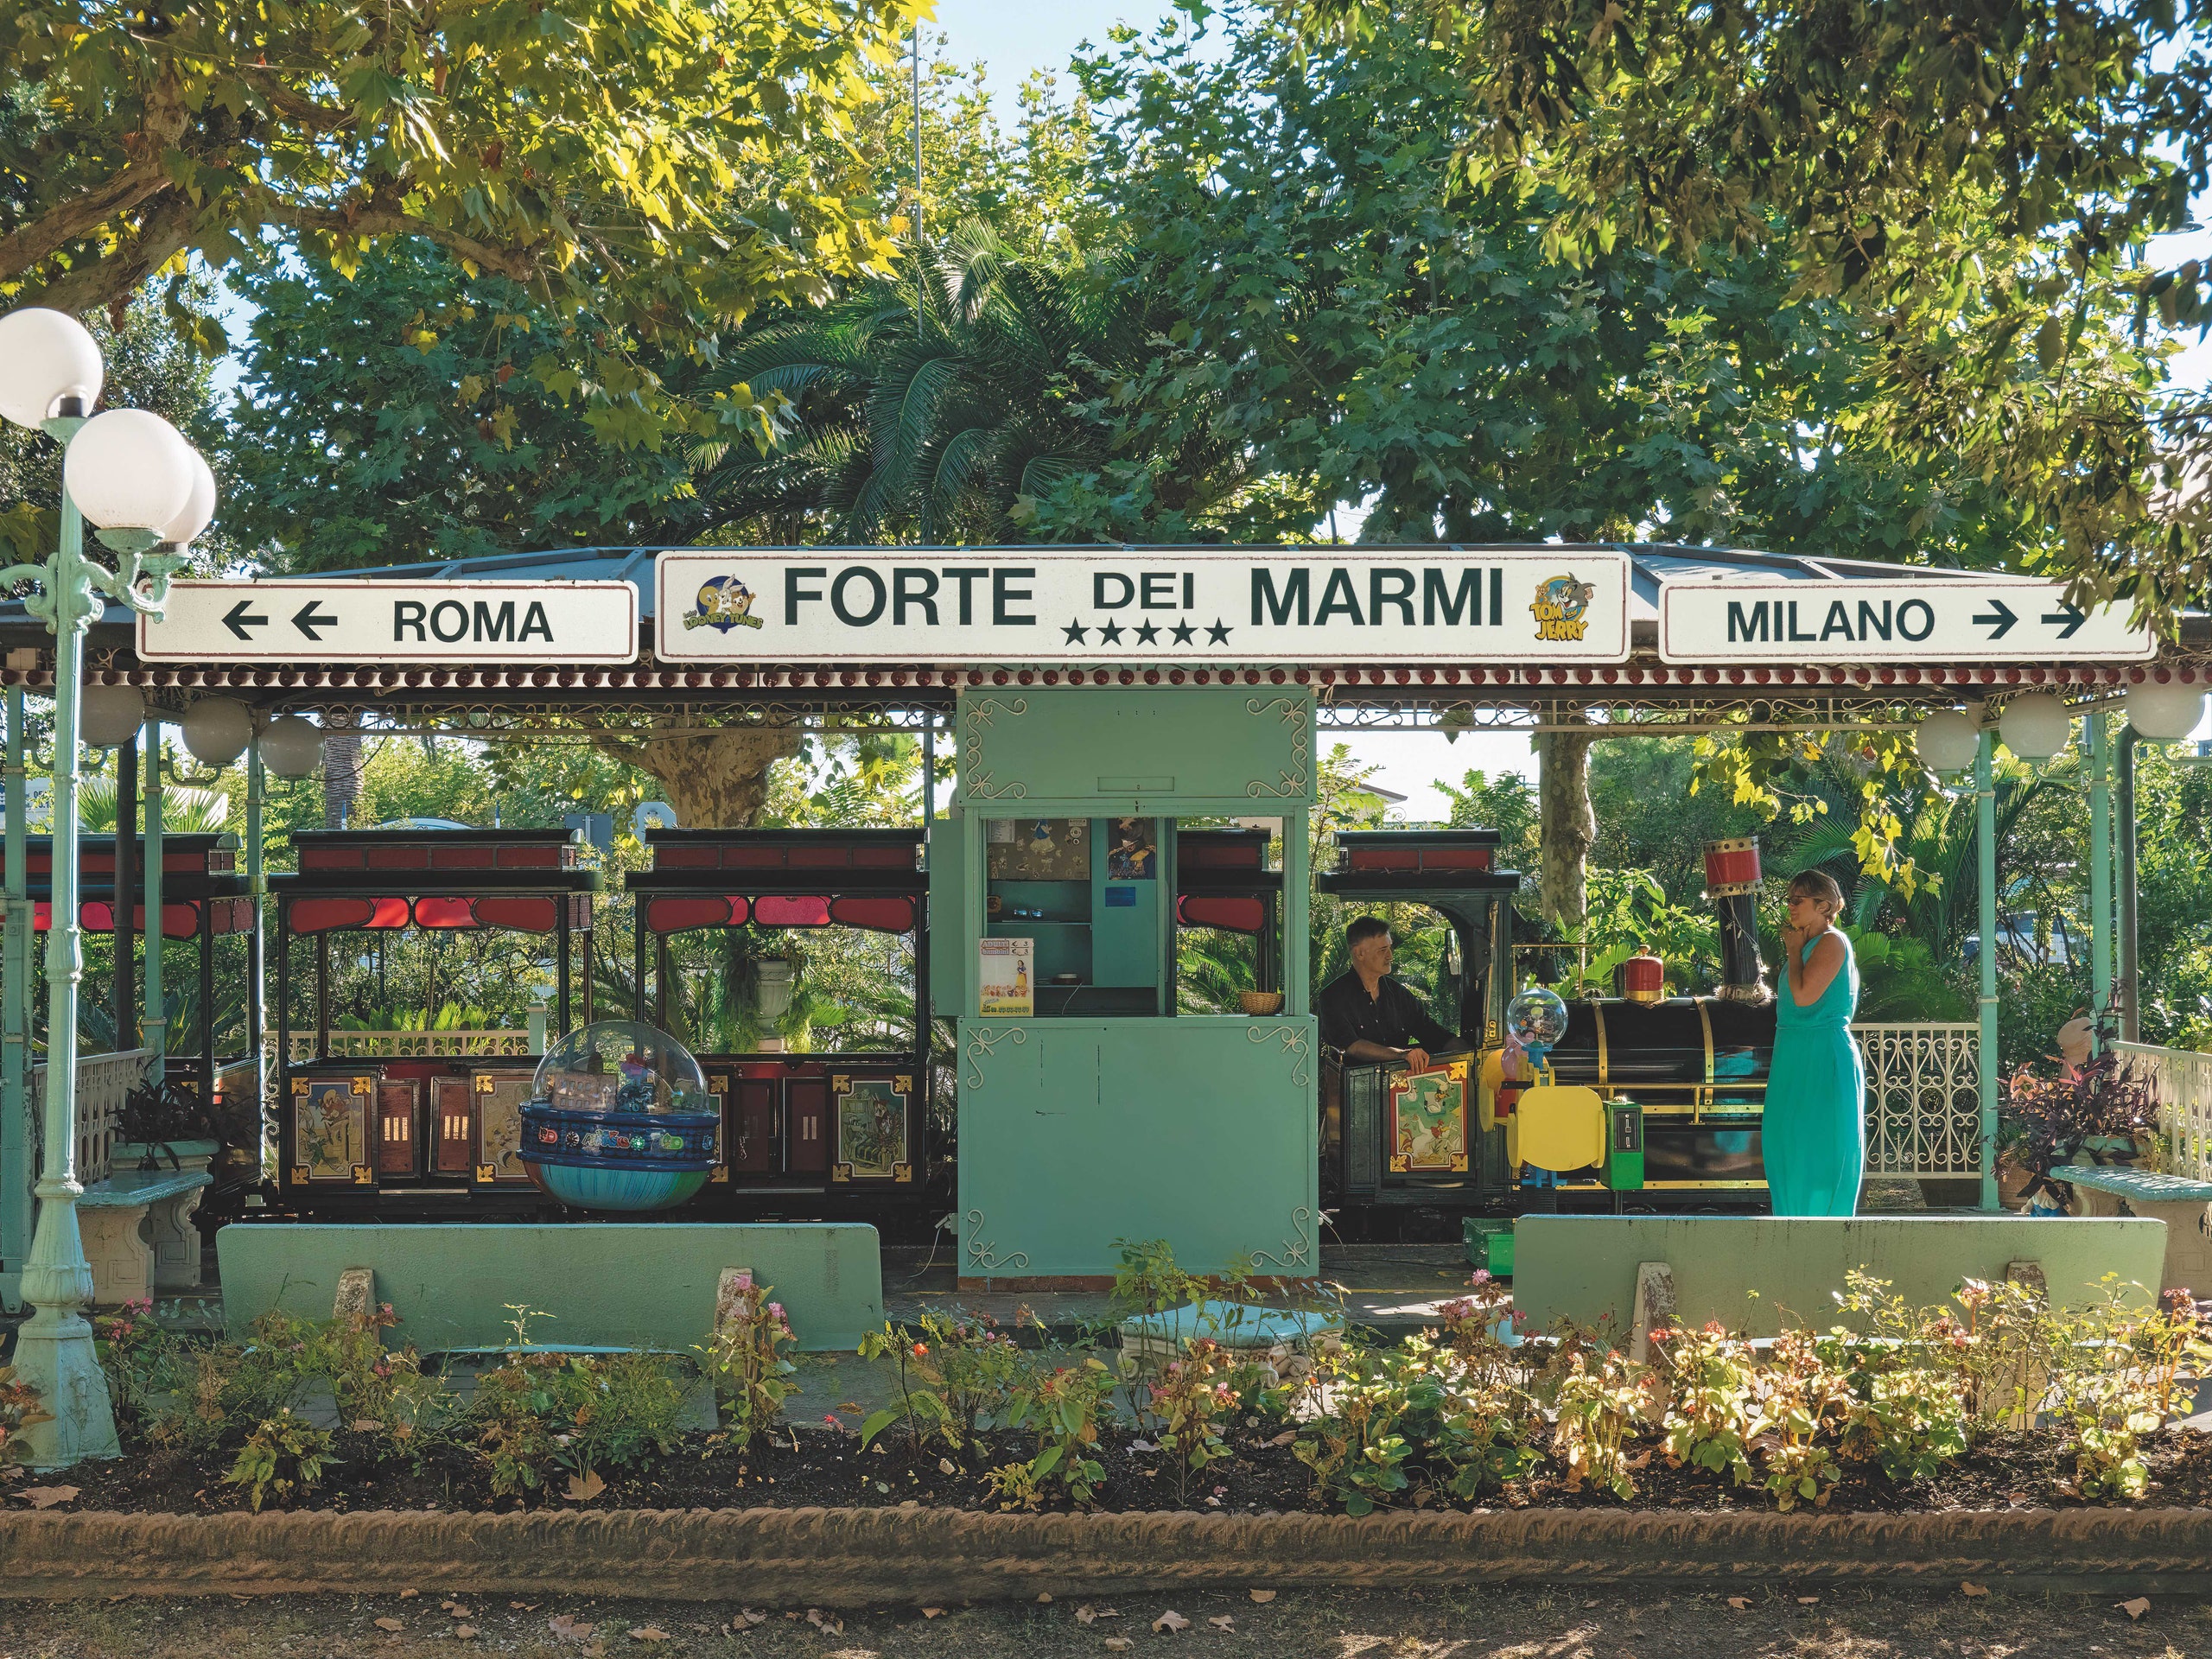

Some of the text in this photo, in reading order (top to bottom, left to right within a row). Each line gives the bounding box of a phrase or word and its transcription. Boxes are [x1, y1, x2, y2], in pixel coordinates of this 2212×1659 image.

[785, 566, 1503, 627] FORTE DEI MARMI
[1529, 602, 1563, 621] TOM
[393, 600, 555, 643] ROMA
[683, 612, 764, 631] LOONEY TUNES
[1535, 620, 1589, 641] JERRY
[1727, 598, 1936, 643] MILANO
